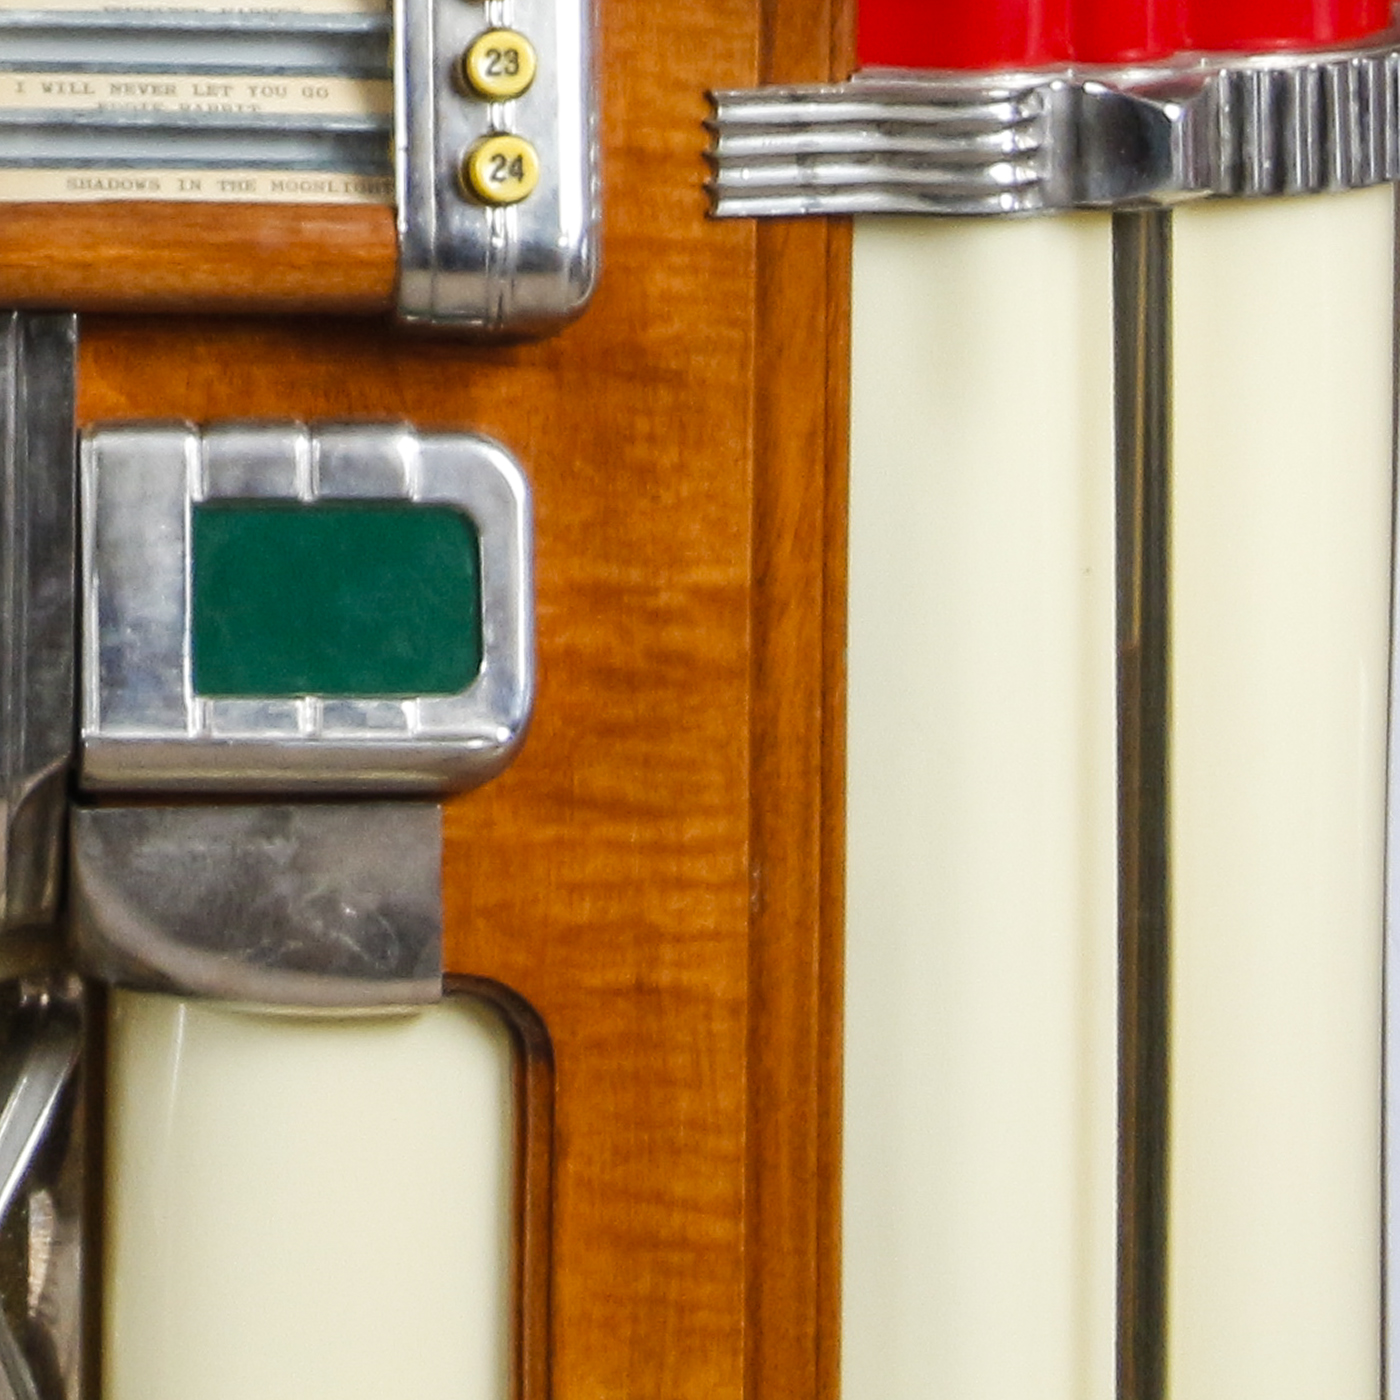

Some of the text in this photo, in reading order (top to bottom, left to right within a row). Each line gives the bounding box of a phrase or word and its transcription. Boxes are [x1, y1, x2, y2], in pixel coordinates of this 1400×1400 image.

[485, 48, 519, 78] 23
[15, 83, 329, 99] I WILL NEVER LET YOU GO
[489, 153, 524, 184] 24
[66, 178, 160, 191] SHADOWS
[178, 178, 202, 191] IN
[217, 179, 257, 191] THE
